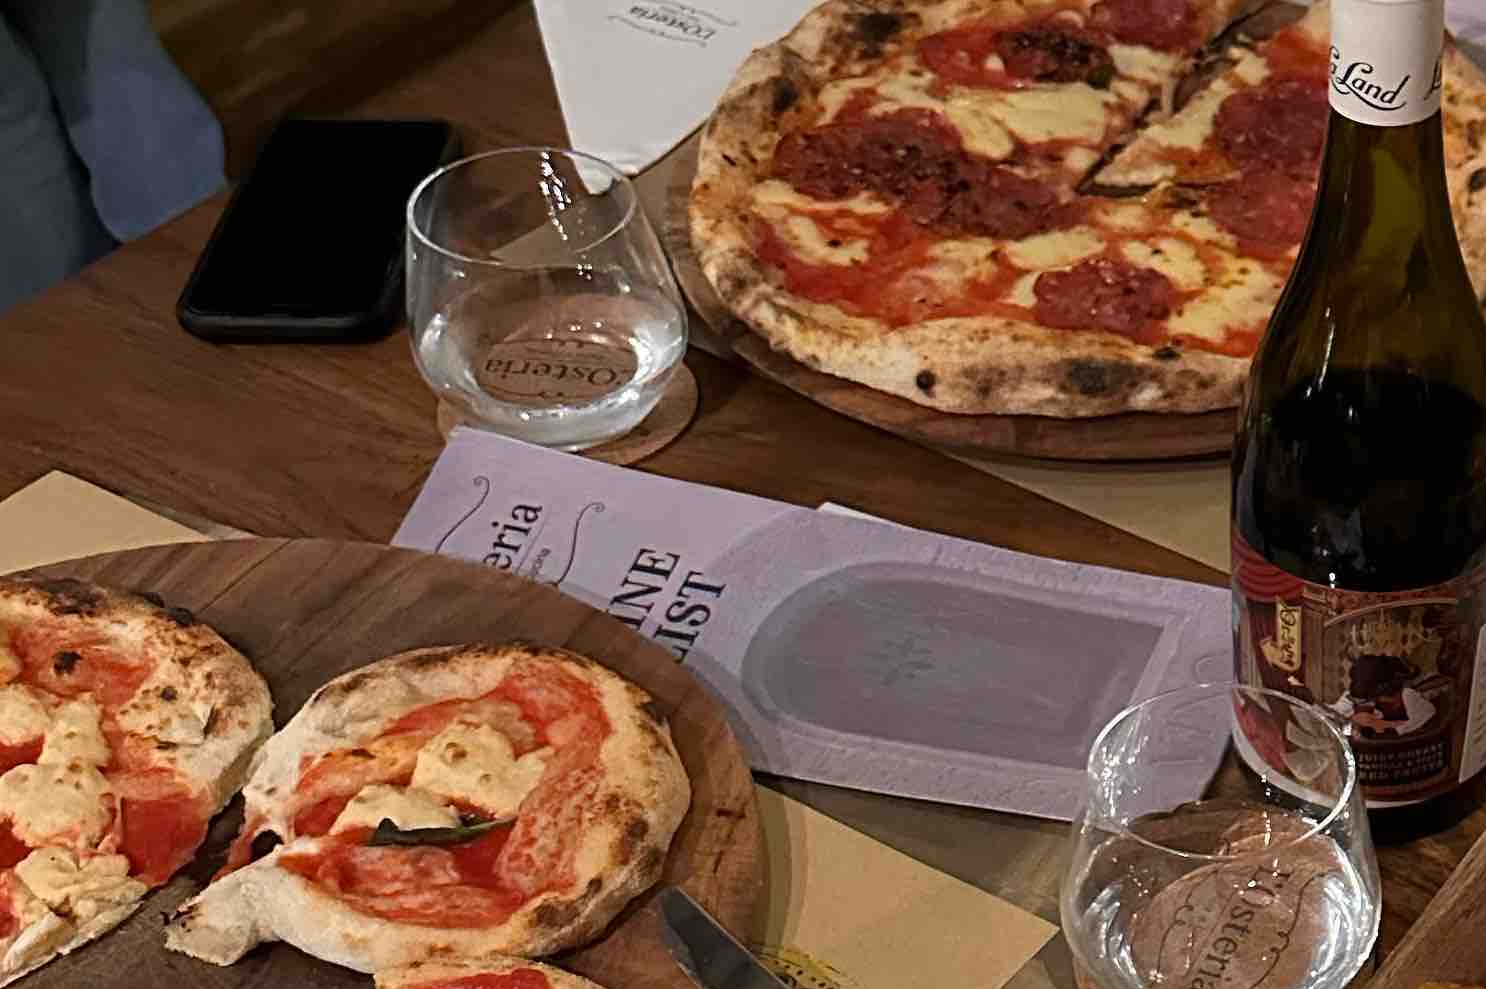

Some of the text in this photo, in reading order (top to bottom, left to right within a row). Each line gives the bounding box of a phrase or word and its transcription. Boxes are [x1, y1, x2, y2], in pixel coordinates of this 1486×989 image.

[1336, 62, 1411, 111] Land
[484, 359, 632, 386] 'Osteria
[482, 503, 543, 570] eria
[608, 548, 681, 631] INE
